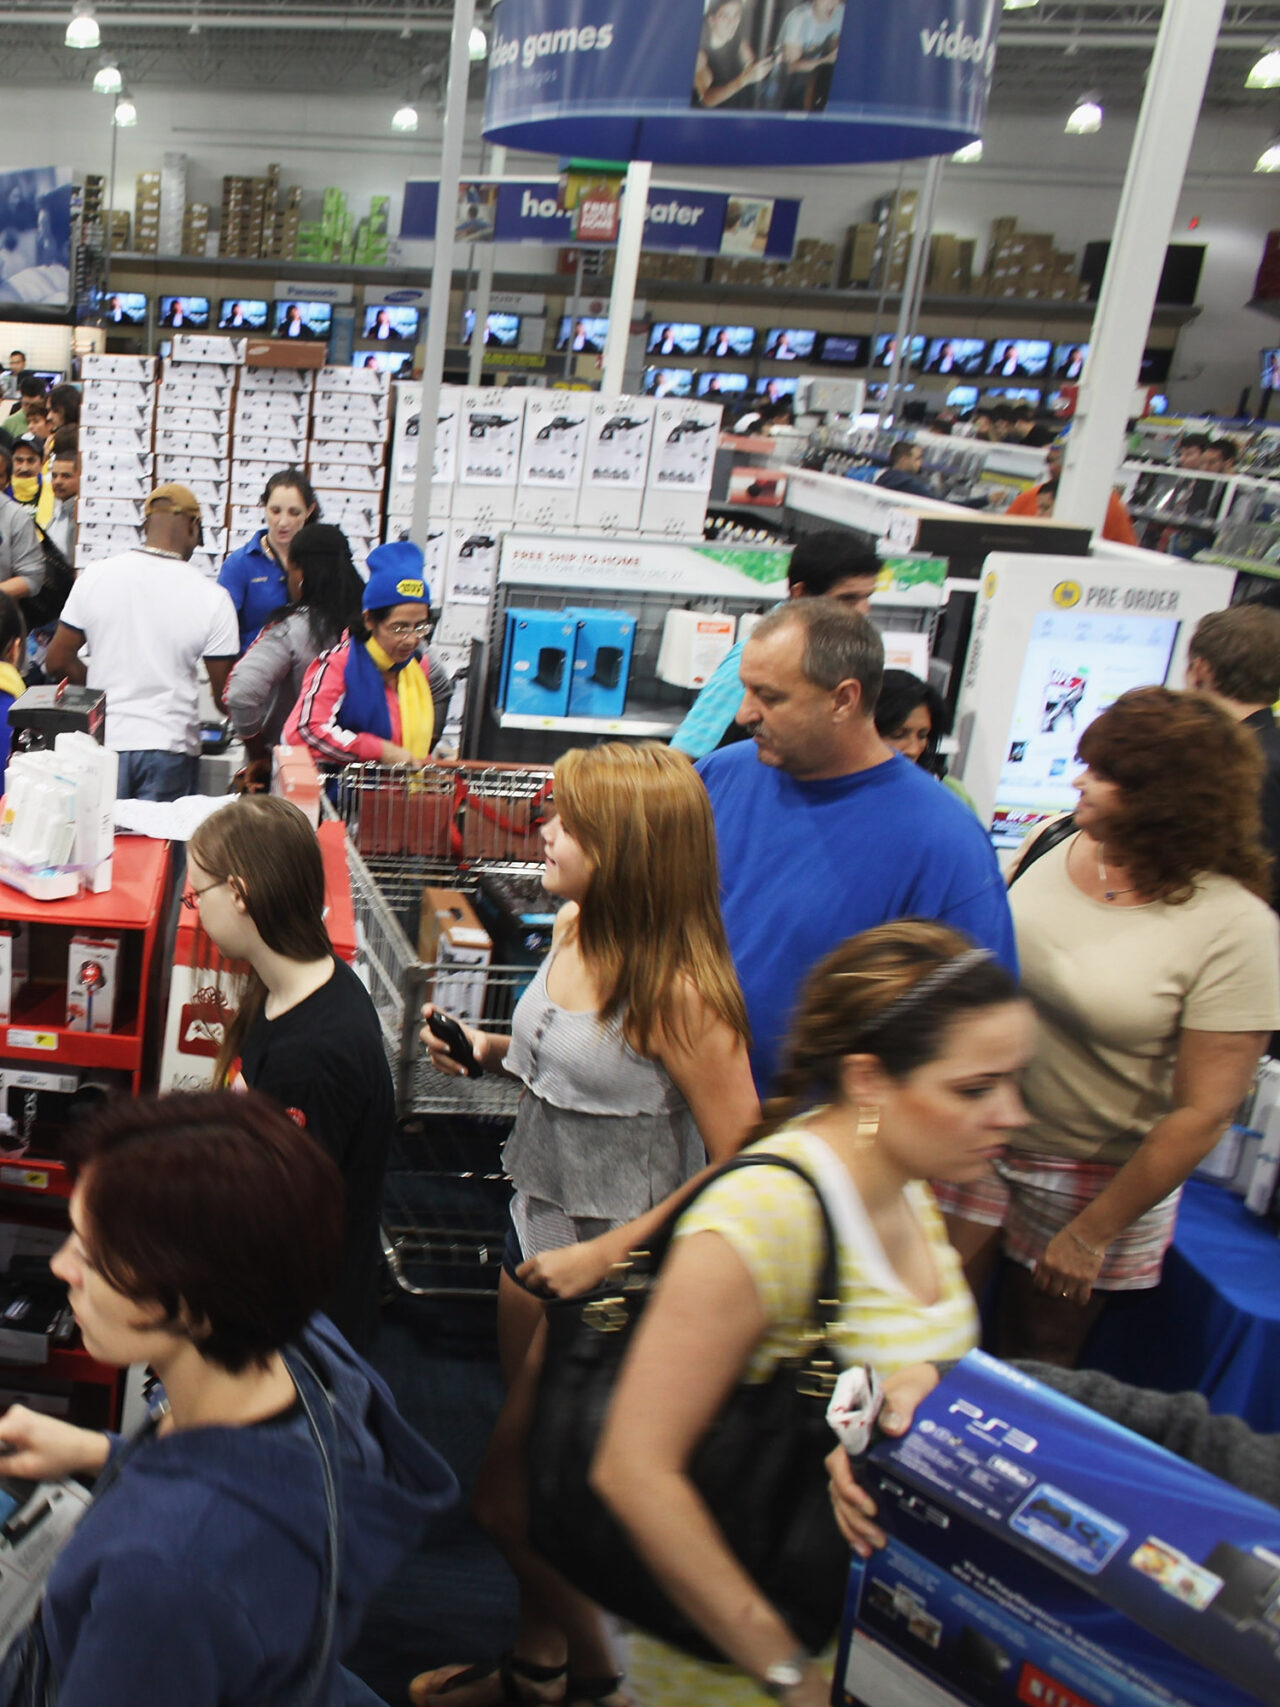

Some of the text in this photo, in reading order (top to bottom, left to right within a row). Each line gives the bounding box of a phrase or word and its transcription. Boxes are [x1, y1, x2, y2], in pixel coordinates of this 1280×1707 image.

[522, 22, 614, 68] games
[920, 18, 984, 63] video
[286, 285, 339, 298] Panasonic
[948, 1397, 1039, 1454] PS3
[879, 1476, 950, 1529] PS3
